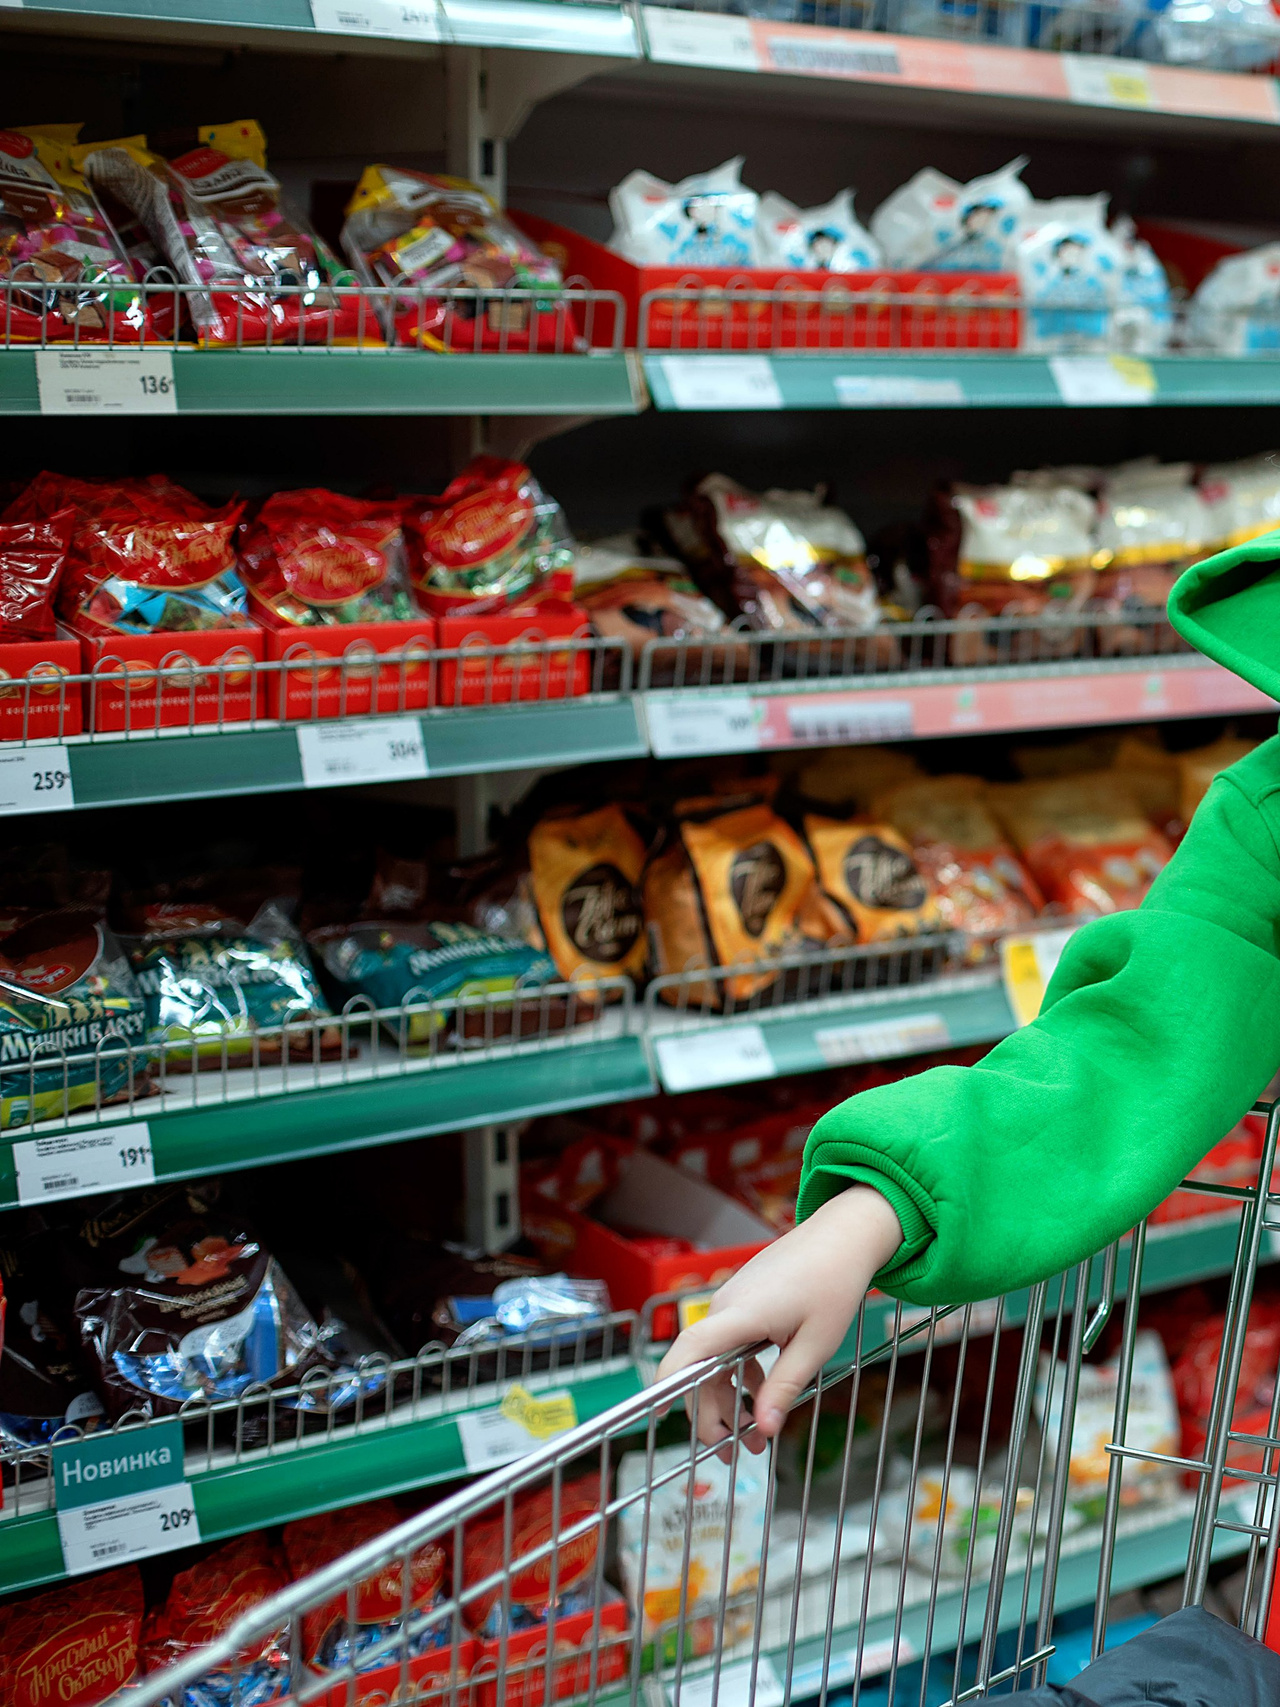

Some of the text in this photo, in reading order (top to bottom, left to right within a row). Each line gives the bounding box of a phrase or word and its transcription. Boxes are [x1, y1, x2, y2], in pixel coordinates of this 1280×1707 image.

[140, 375, 170, 394] 136
[33, 770, 66, 790] 259
[119, 1146, 147, 1168] 191
[62, 1446, 172, 1487] Новинка
[160, 1508, 191, 1531] 209
